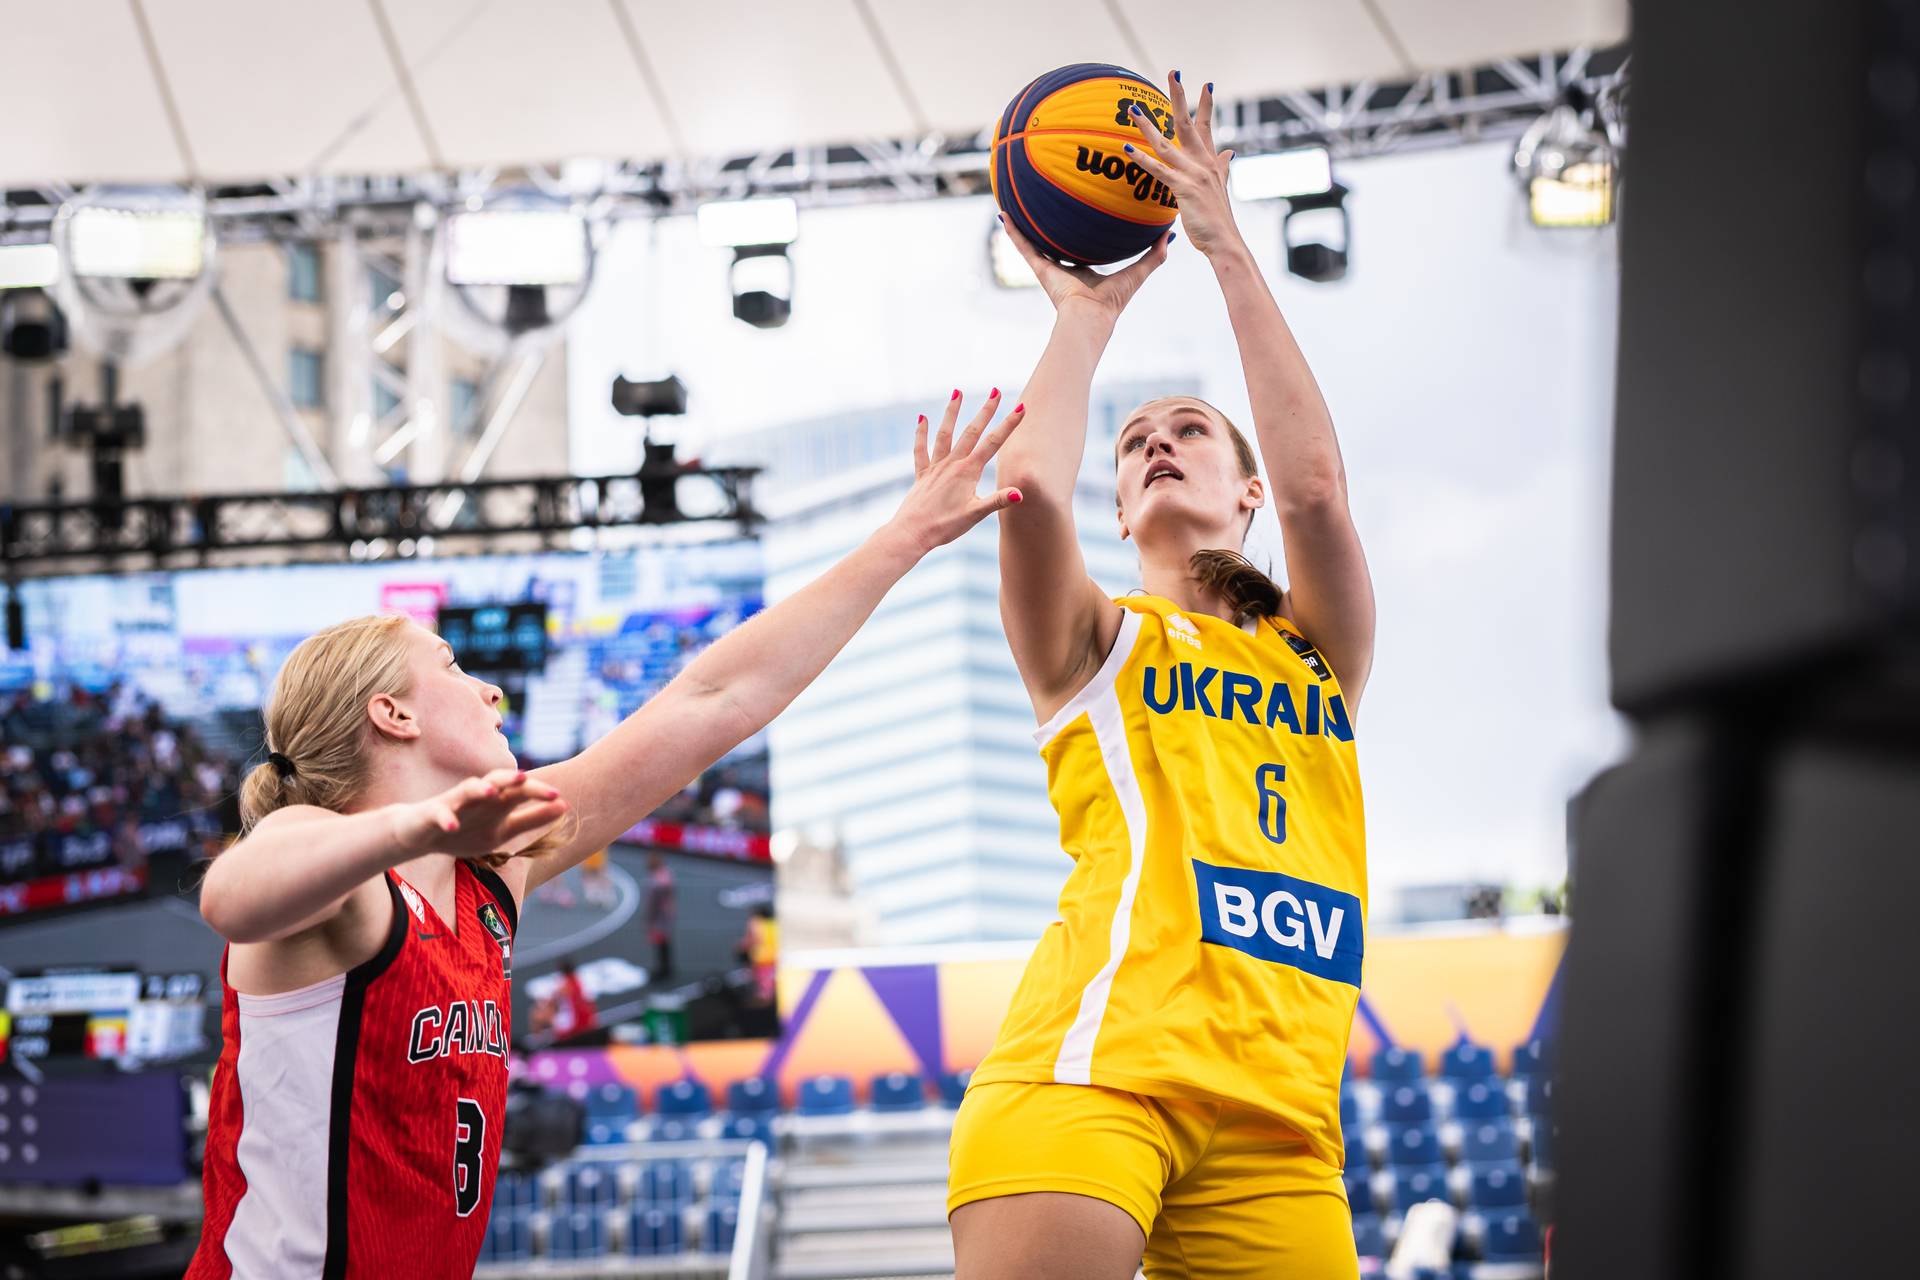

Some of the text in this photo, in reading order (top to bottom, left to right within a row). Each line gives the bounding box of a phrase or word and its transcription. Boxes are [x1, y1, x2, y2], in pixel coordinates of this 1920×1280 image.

[1118, 83, 1138, 93] BALL
[1255, 763, 1287, 844] 6
[1213, 881, 1345, 960] BGV
